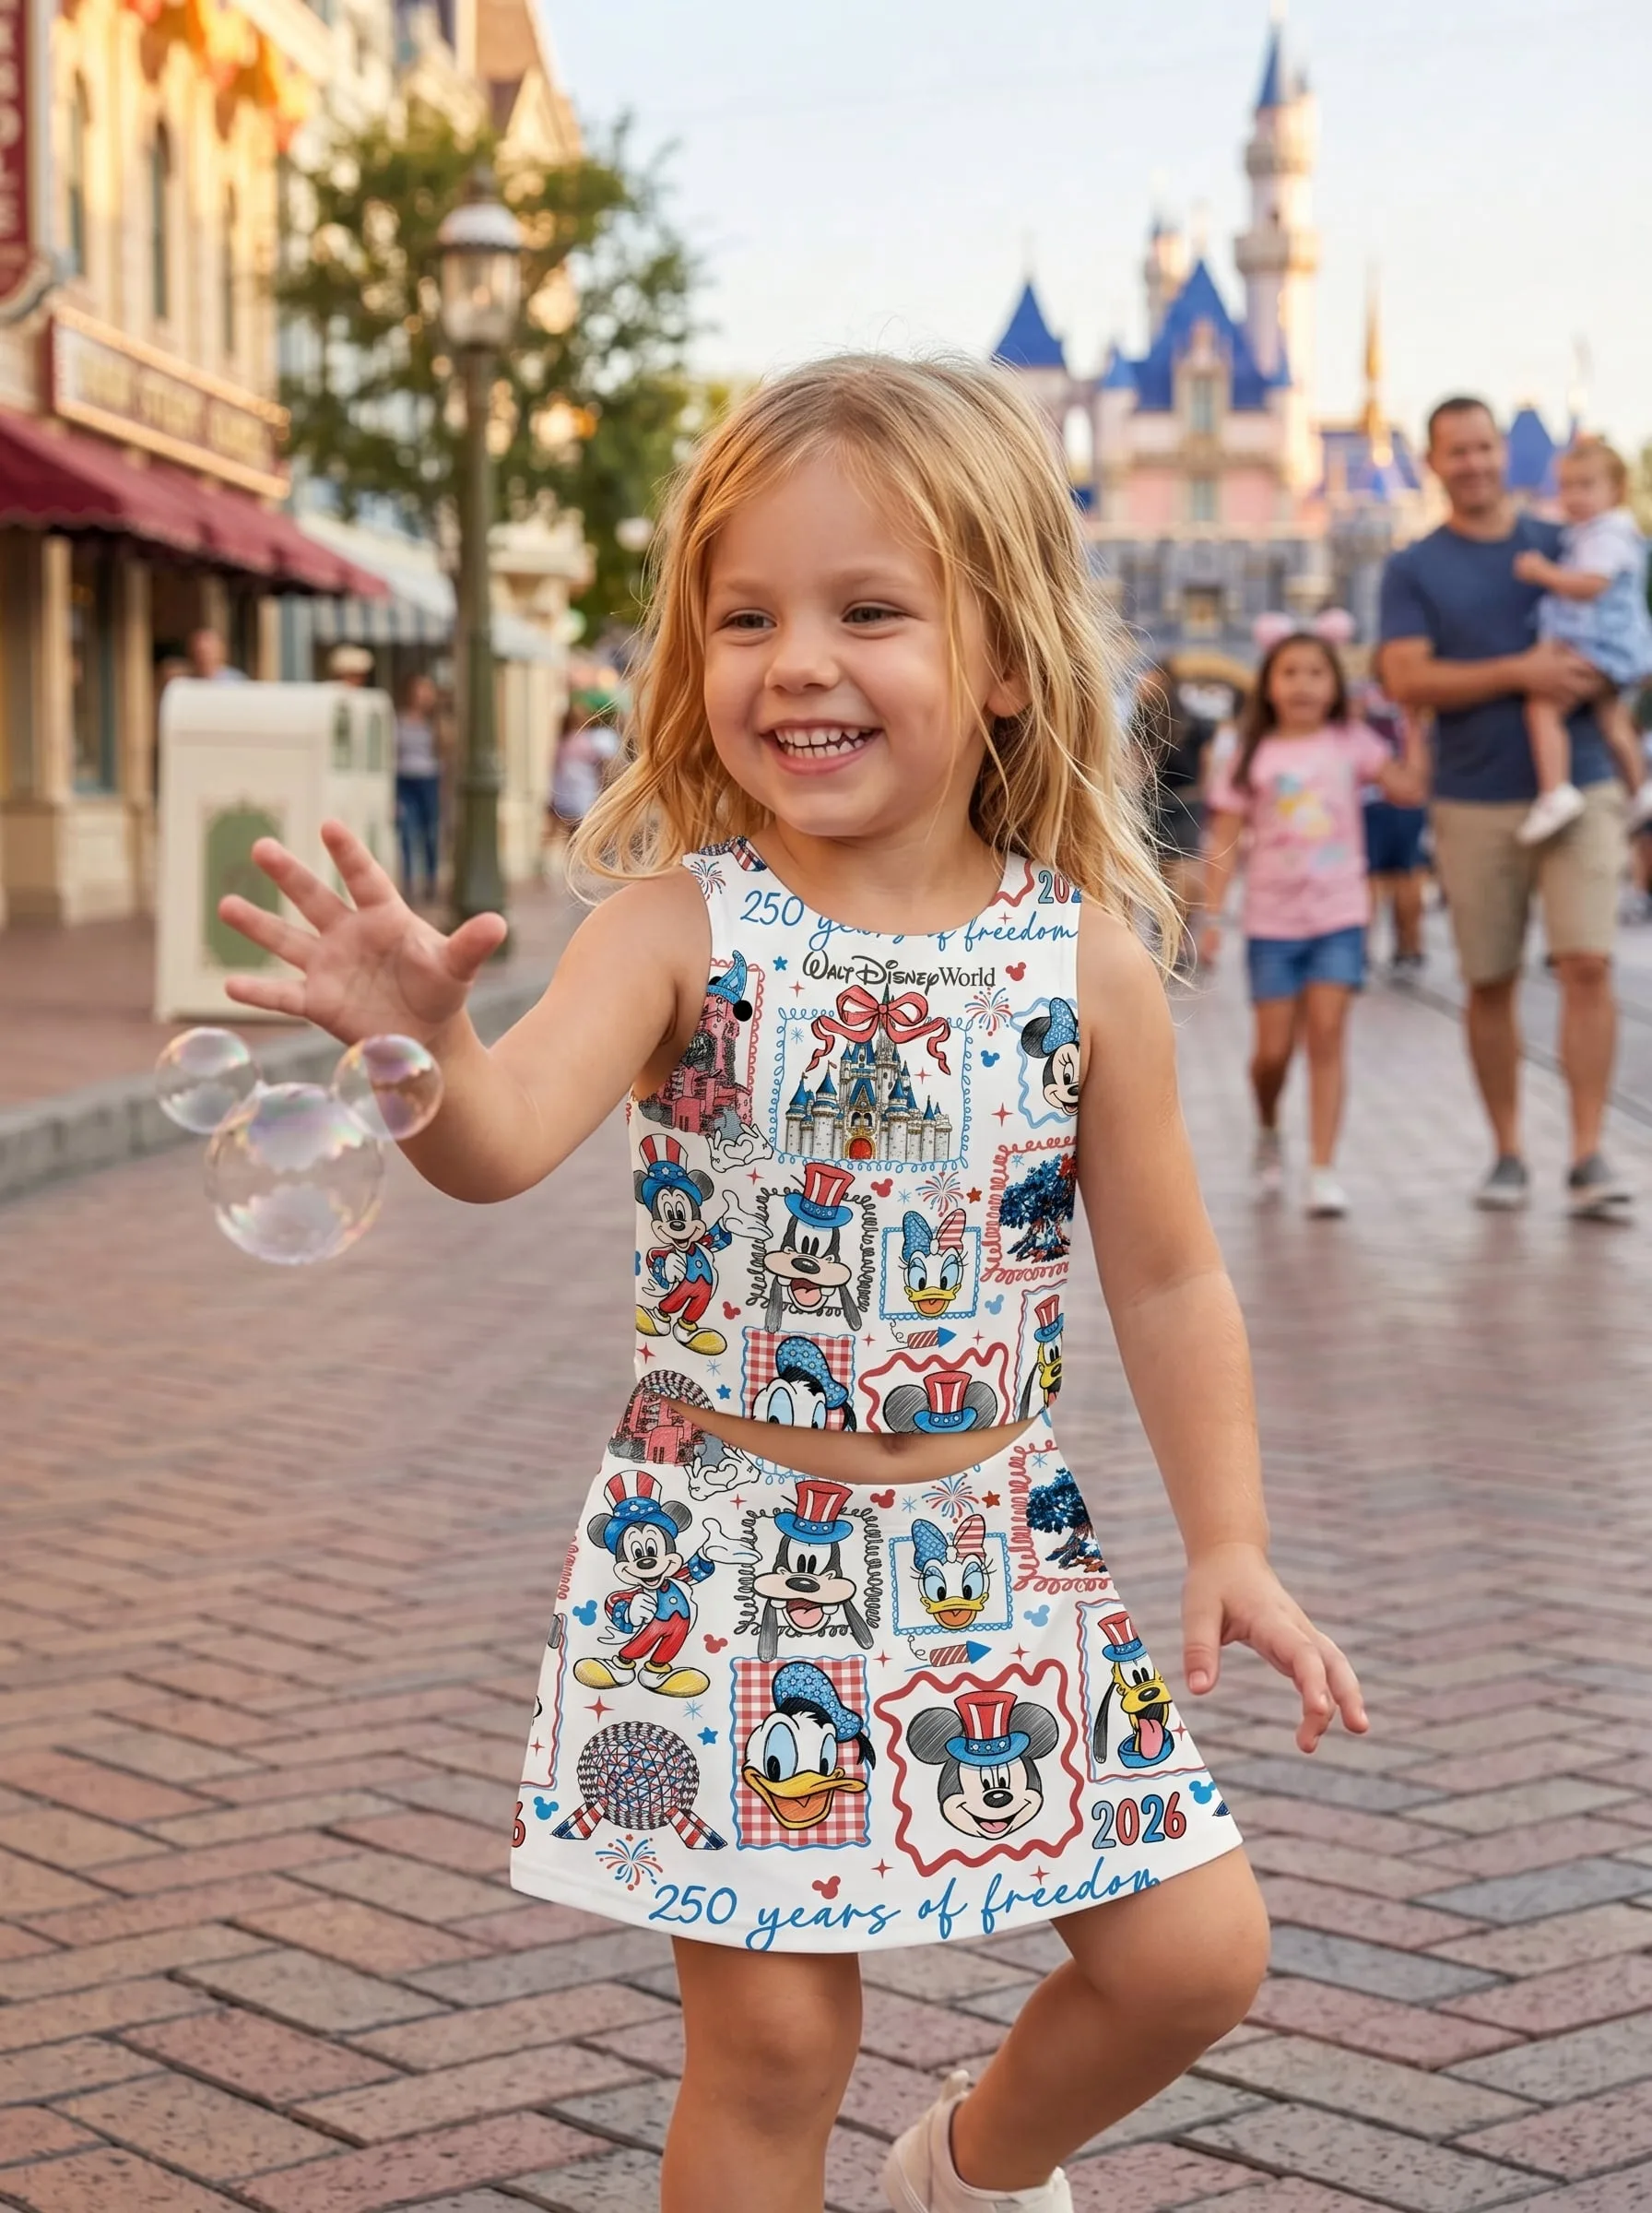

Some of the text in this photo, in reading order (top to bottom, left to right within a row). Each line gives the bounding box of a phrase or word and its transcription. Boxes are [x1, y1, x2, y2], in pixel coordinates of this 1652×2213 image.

[739, 890, 805, 927] 250
[964, 910, 1079, 952] freedom
[938, 966, 997, 987] World
[1092, 1792, 1187, 1850] 2026
[648, 1856, 1162, 1952] 250 years of freedom
